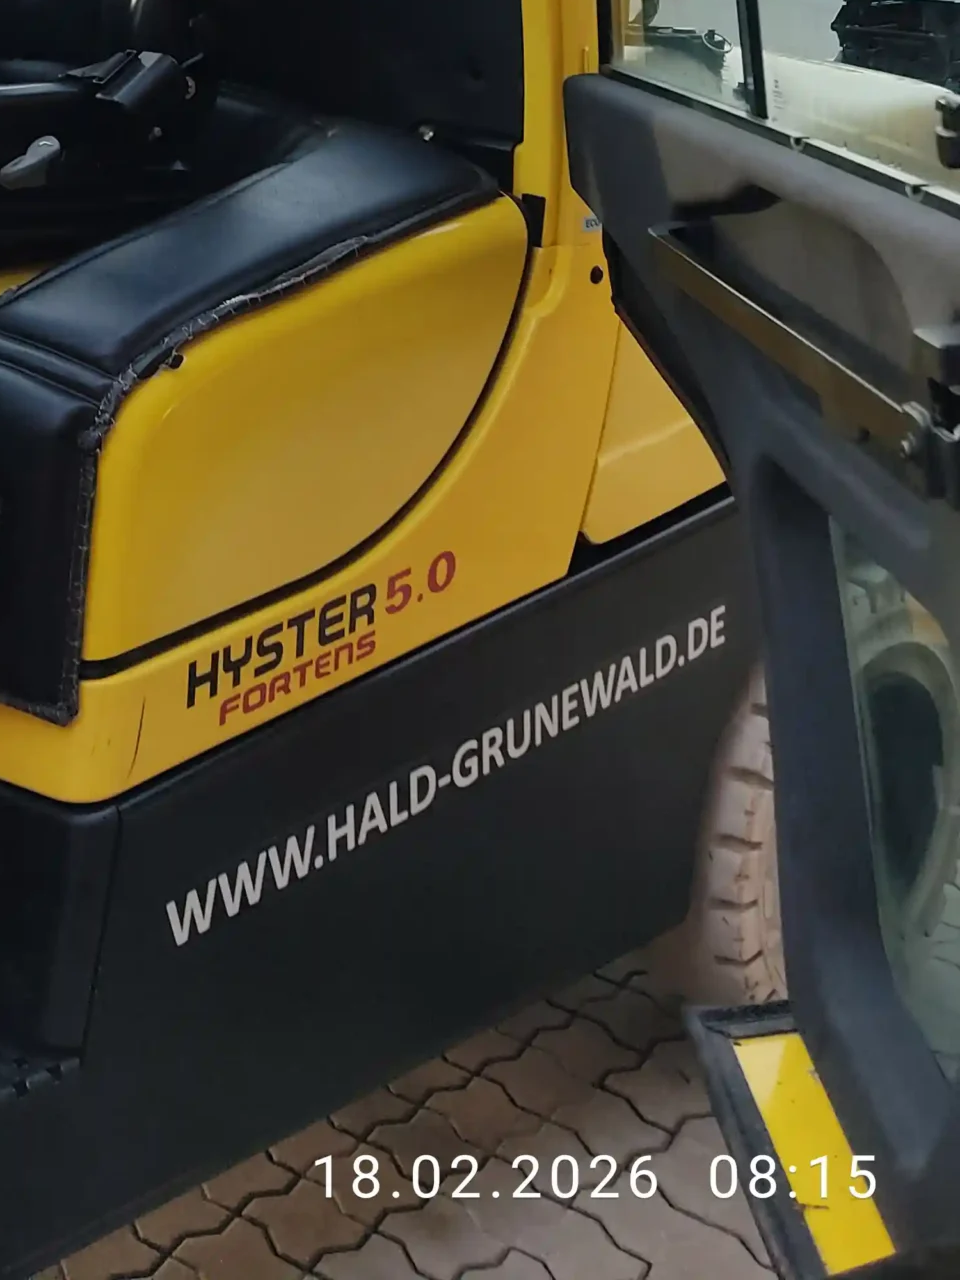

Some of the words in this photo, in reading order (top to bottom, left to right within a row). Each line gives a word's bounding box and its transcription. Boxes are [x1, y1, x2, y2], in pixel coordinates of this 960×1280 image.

[186, 582, 377, 710] HYSTER
[384, 550, 457, 615] 5.0
[218, 630, 377, 727] FORTENS
[165, 604, 727, 947] WWW.HALD-GRUNEWALD.DE
